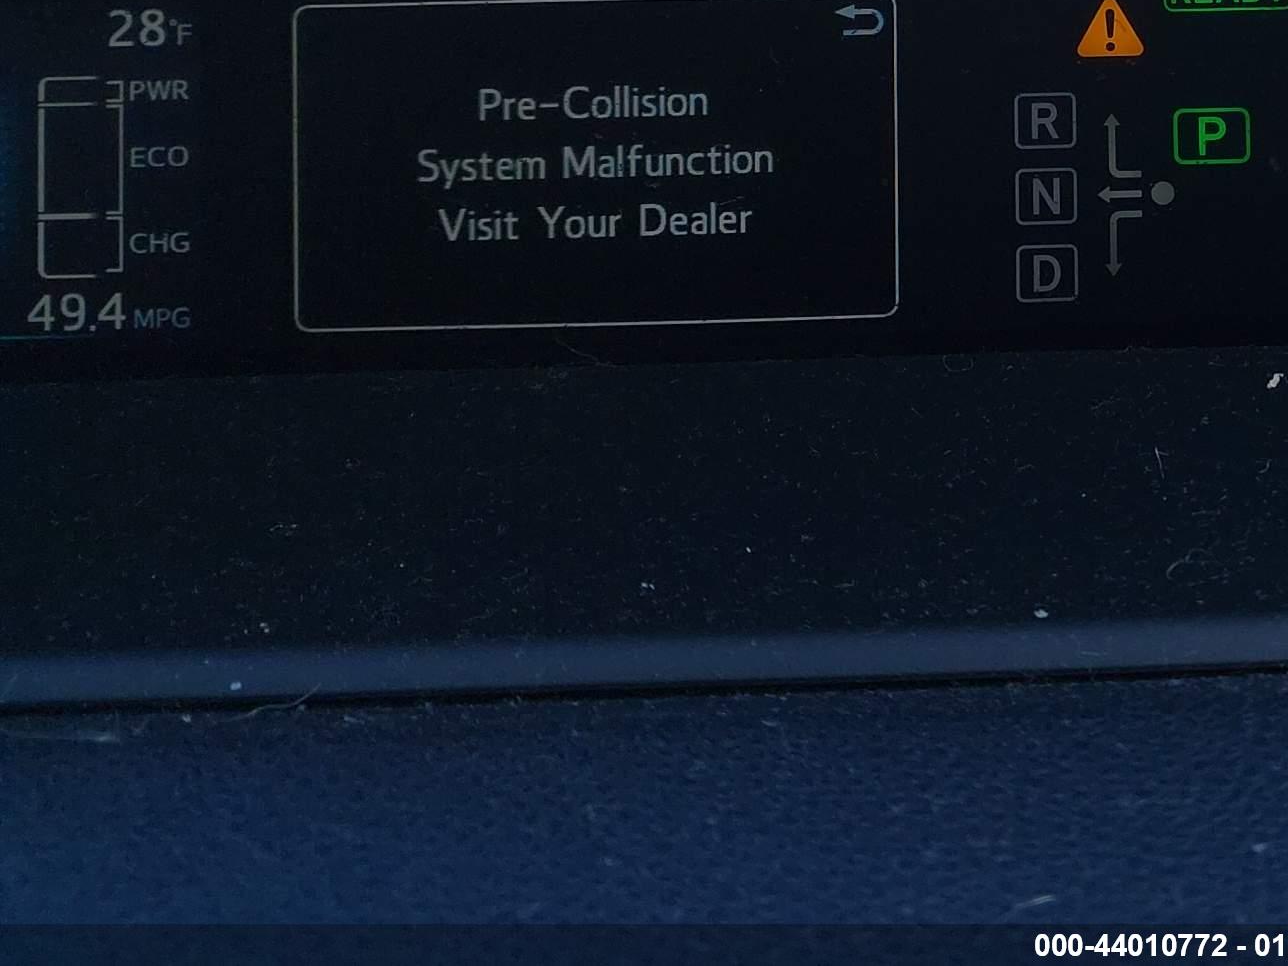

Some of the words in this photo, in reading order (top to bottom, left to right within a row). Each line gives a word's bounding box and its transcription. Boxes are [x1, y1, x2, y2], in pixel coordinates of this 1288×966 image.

[129, 80, 189, 101] PWR
[479, 85, 708, 121] Pre-Collision
[1031, 103, 1059, 139] R
[1198, 116, 1227, 156] P
[130, 146, 189, 167] ECO
[418, 149, 546, 189] System
[562, 144, 774, 179] Malfunction
[1032, 178, 1061, 215] N
[438, 208, 519, 241] Visit
[538, 206, 621, 238] Your
[640, 201, 753, 236] Dealer
[129, 232, 191, 254] CHG
[1034, 255, 1061, 292] D
[27, 293, 126, 331] 49.4
[134, 307, 191, 329] MPG
